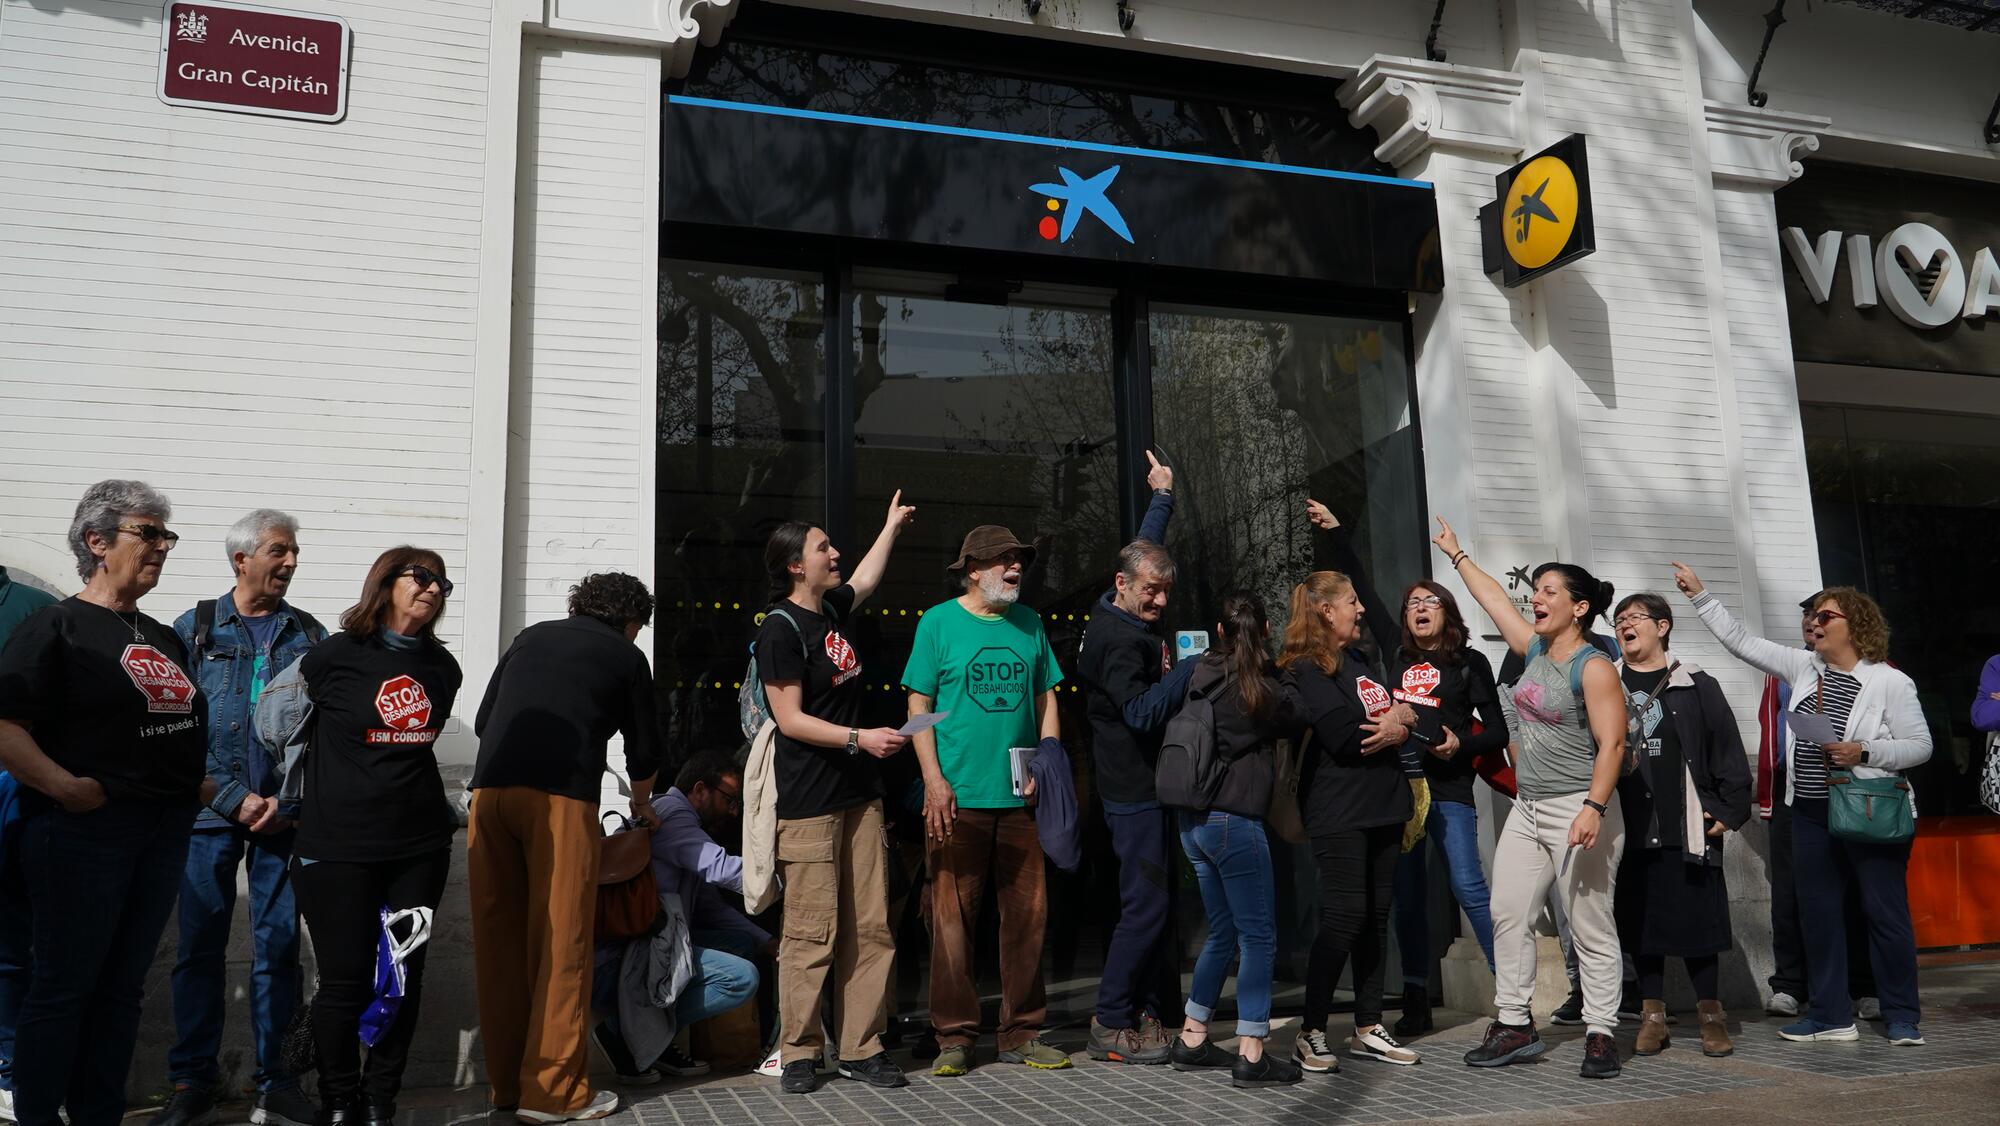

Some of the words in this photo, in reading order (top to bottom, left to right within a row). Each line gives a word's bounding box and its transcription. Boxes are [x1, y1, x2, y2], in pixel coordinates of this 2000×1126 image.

[229, 29, 320, 54] Avenida
[178, 62, 233, 84] Gran
[242, 70, 328, 95] Capitán
[128, 659, 178, 679] STOP
[972, 662, 1025, 682] STOP
[1406, 668, 1436, 680] STOP
[138, 676, 188, 688] DESAHUCIOS
[972, 682, 1024, 694] DESAHUCIOS
[380, 684, 420, 712] STOP
[1362, 688, 1386, 704] STOP
[384, 698, 430, 722] DESAHUCIOS
[156, 726, 166, 734] se
[167, 718, 194, 734] puede
[370, 732, 390, 742] 15M
